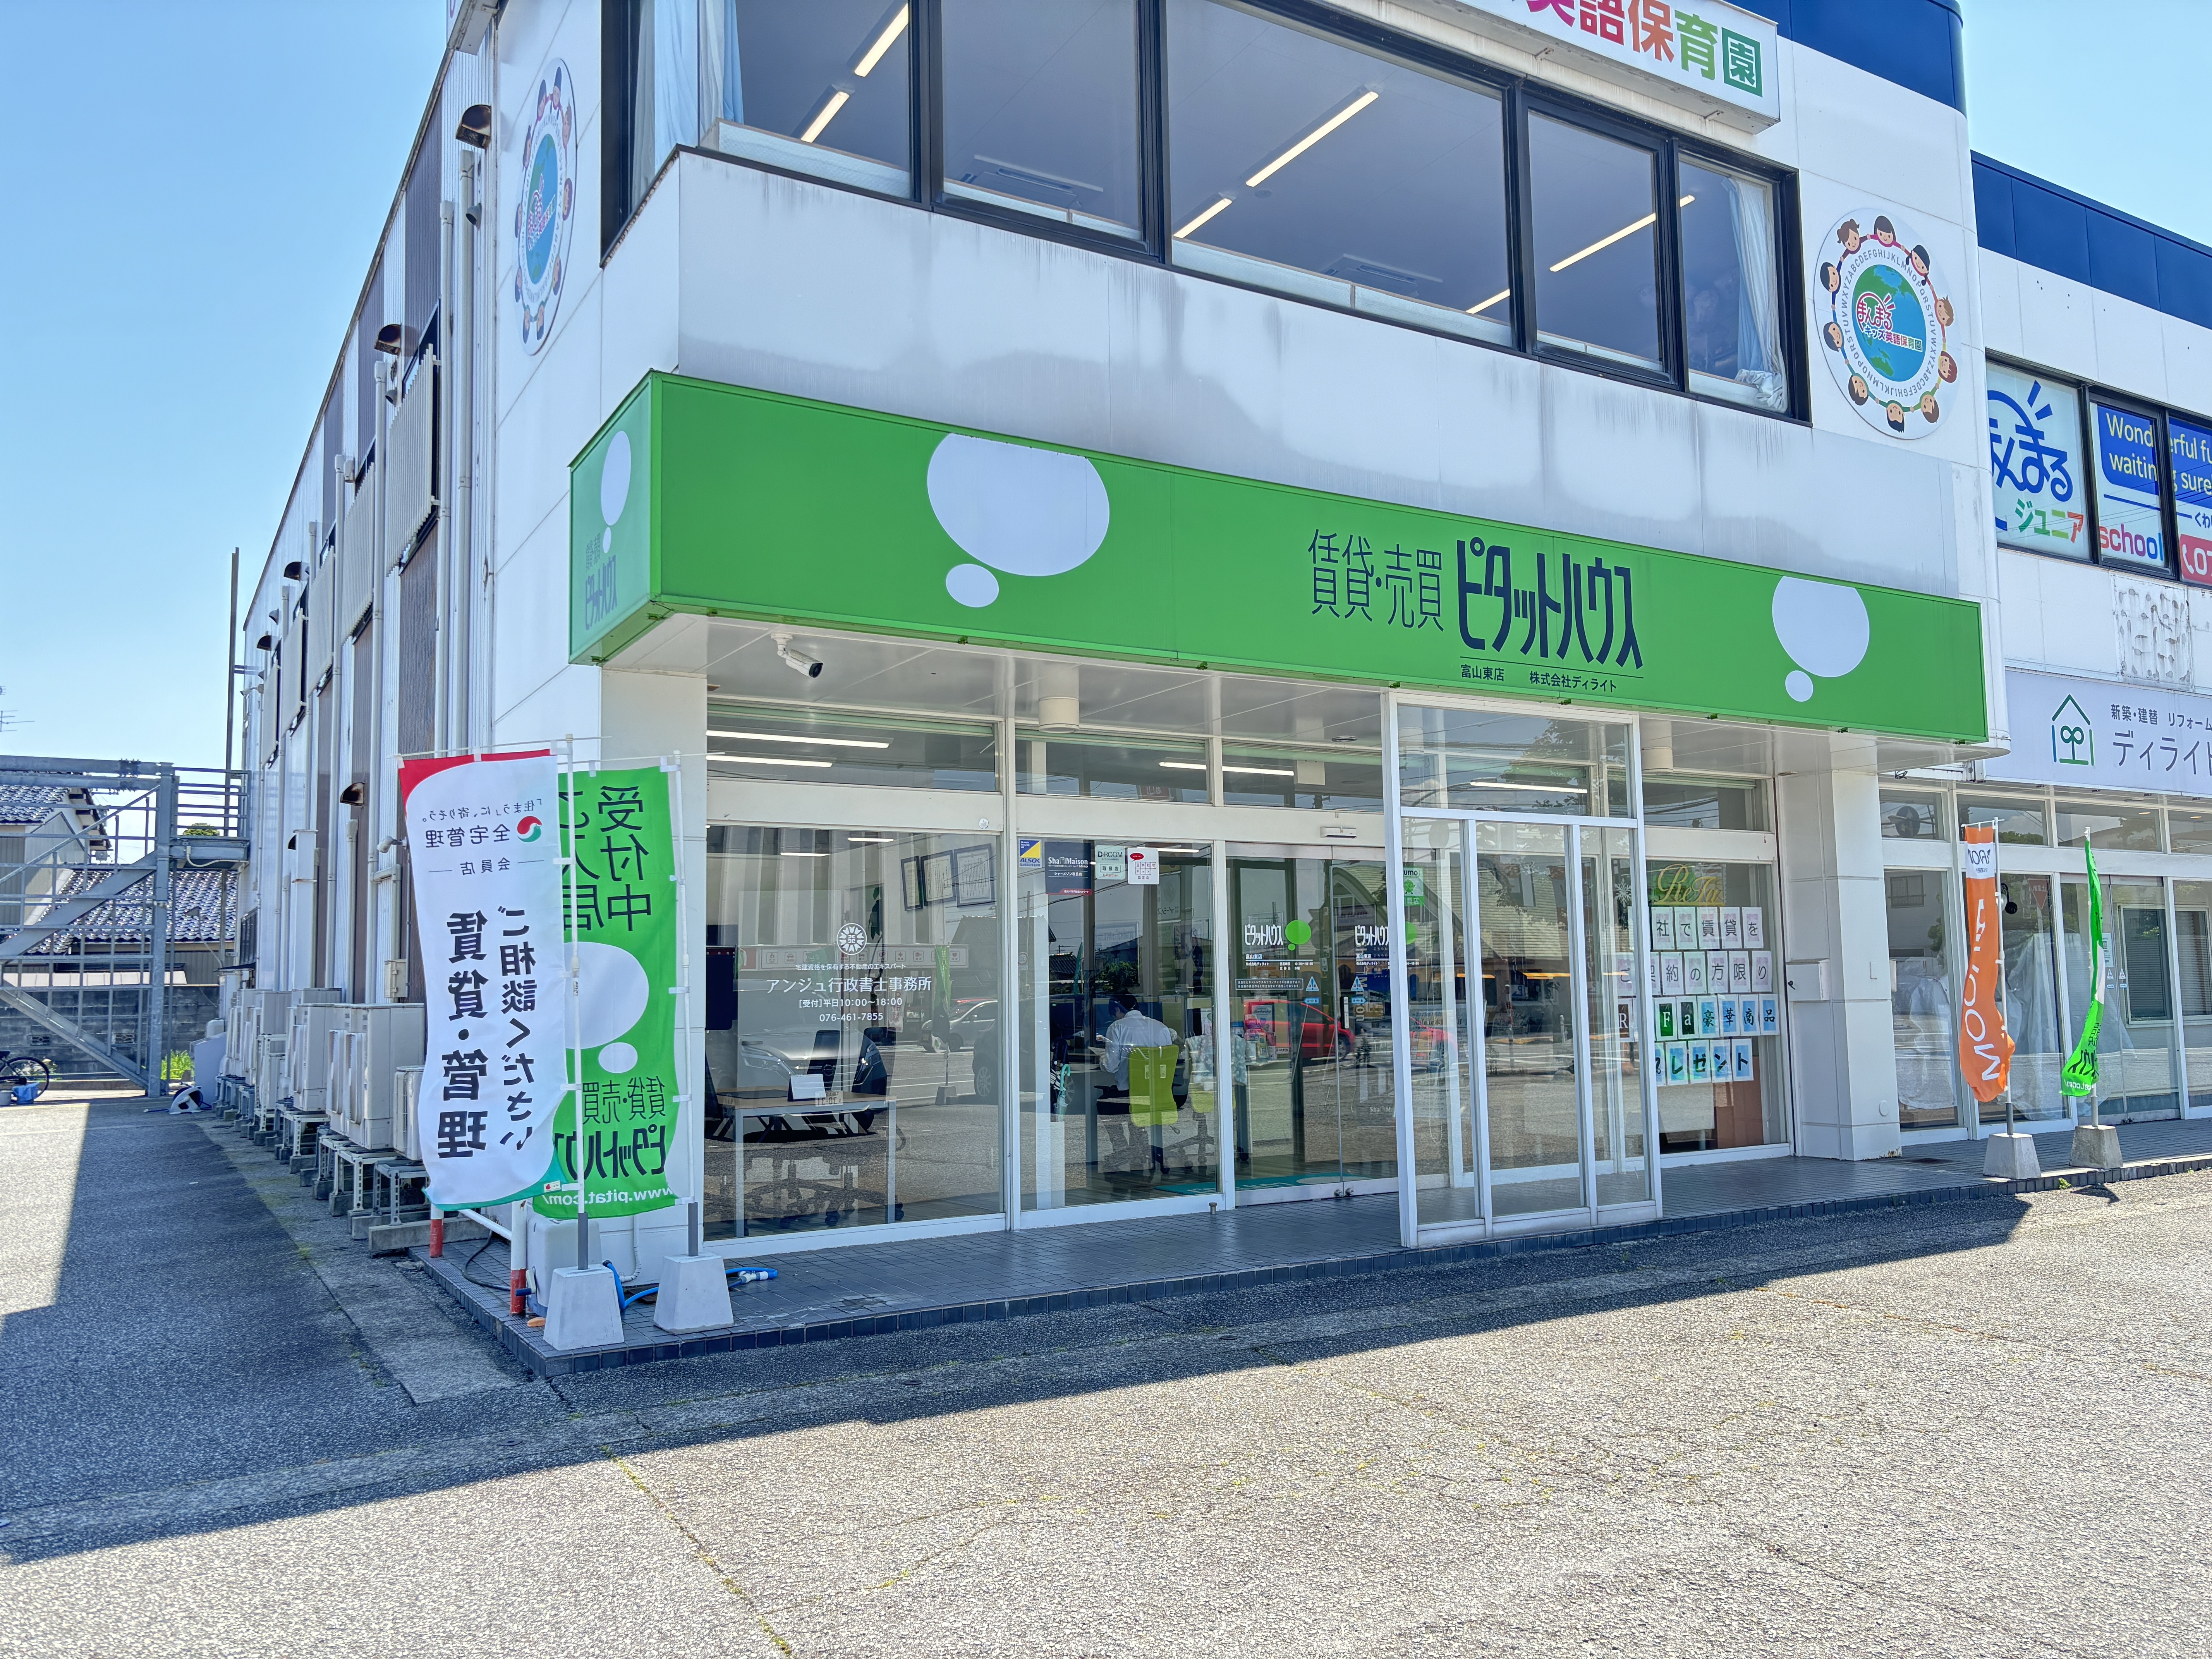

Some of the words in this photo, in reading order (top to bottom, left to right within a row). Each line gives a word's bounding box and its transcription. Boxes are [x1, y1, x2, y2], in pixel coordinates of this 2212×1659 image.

[1857, 300, 1893, 330] まんまる
[1865, 325, 1922, 352] キッズ英語保育園
[2181, 472, 2212, 495] sure
[2015, 498, 2084, 544] ジュニア
[2195, 512, 2212, 529] くわ
[2099, 524, 2164, 561] school
[1308, 529, 1444, 632] 賃貸・売買
[1456, 537, 1644, 670] ピタットハウス
[1461, 664, 1504, 682] 富山東店
[1530, 670, 1617, 693] 株式会社ディライト
[2111, 704, 2158, 725] 新築・建替
[1066, 857, 1088, 865] Maison
[1244, 924, 1284, 946] ピタットハウス
[767, 976, 932, 993] アンジュ行政書士事務所
[819, 1012, 883, 1022] 076-461-7855
